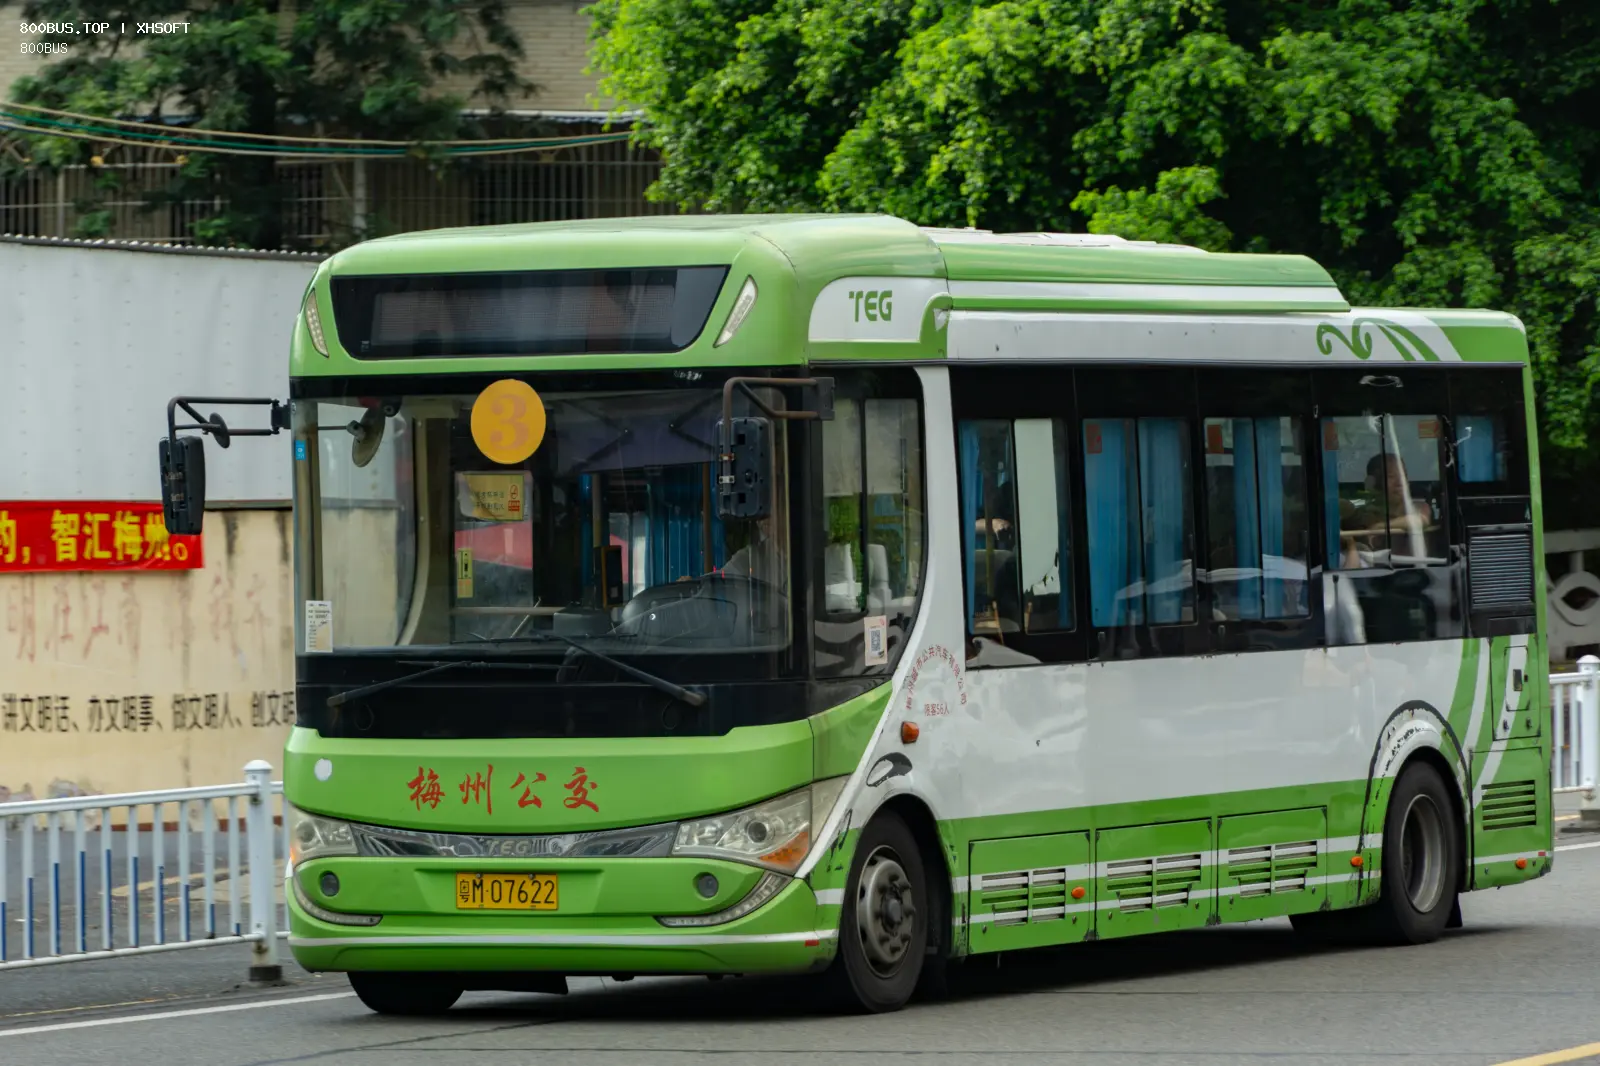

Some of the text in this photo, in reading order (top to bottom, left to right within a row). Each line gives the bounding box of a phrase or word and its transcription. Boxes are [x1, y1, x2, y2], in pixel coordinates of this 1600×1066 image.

[848, 290, 893, 322] TEG
[489, 393, 529, 450] 3
[406, 764, 599, 815] 梅州公交
